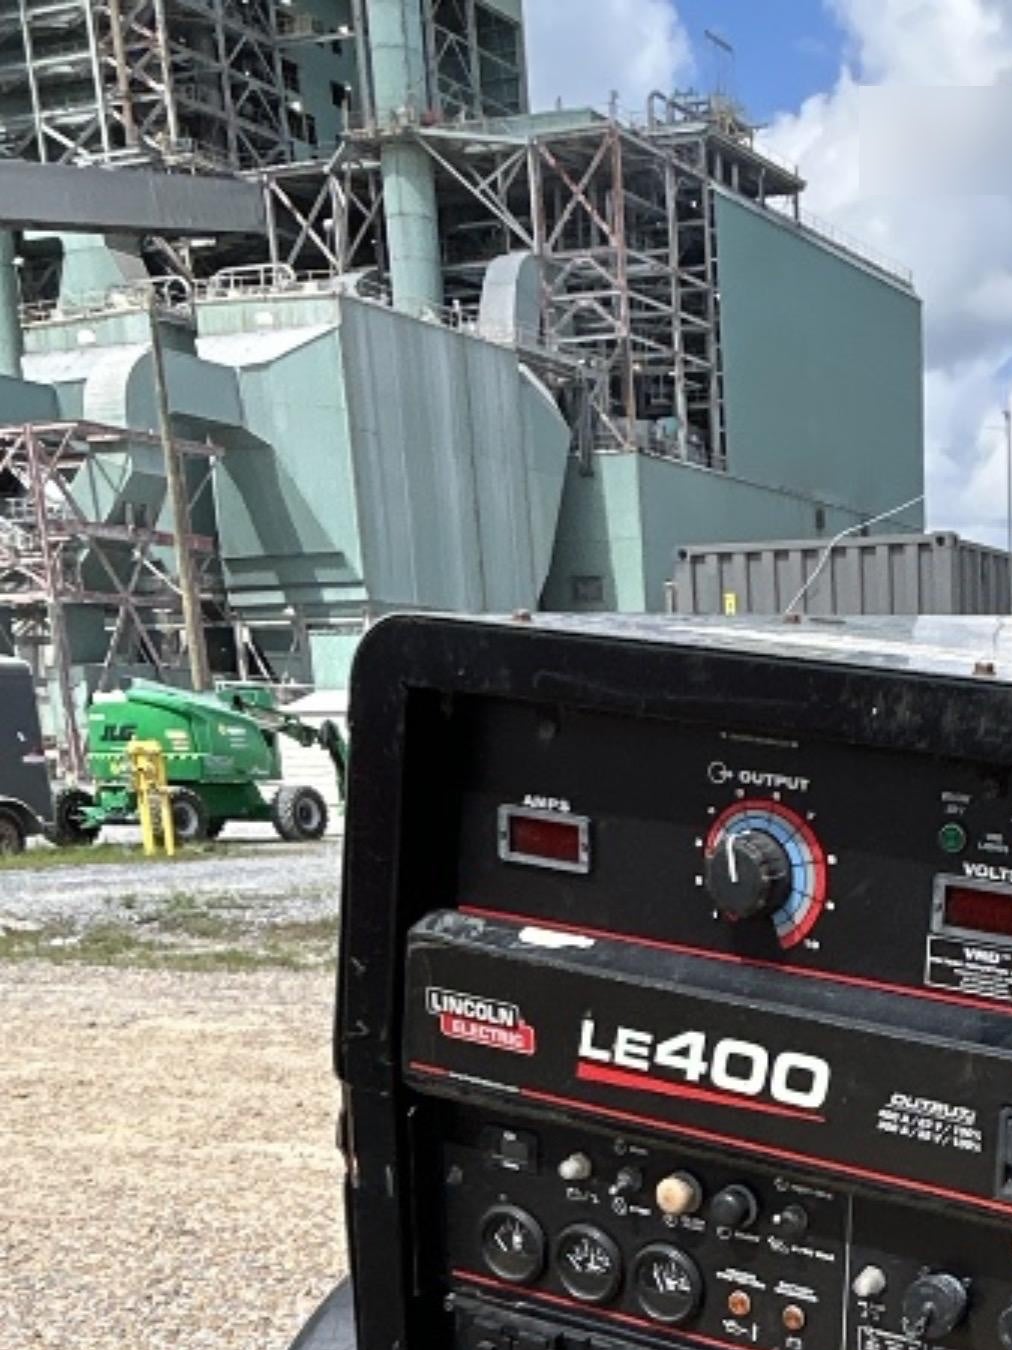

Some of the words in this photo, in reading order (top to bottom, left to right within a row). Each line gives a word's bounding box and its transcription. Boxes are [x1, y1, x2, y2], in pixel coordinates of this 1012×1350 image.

[738, 769, 811, 791] OUTPUT
[523, 794, 571, 813] AMPS
[430, 991, 515, 1028] LINCOLN
[578, 1018, 830, 1109] LE400
